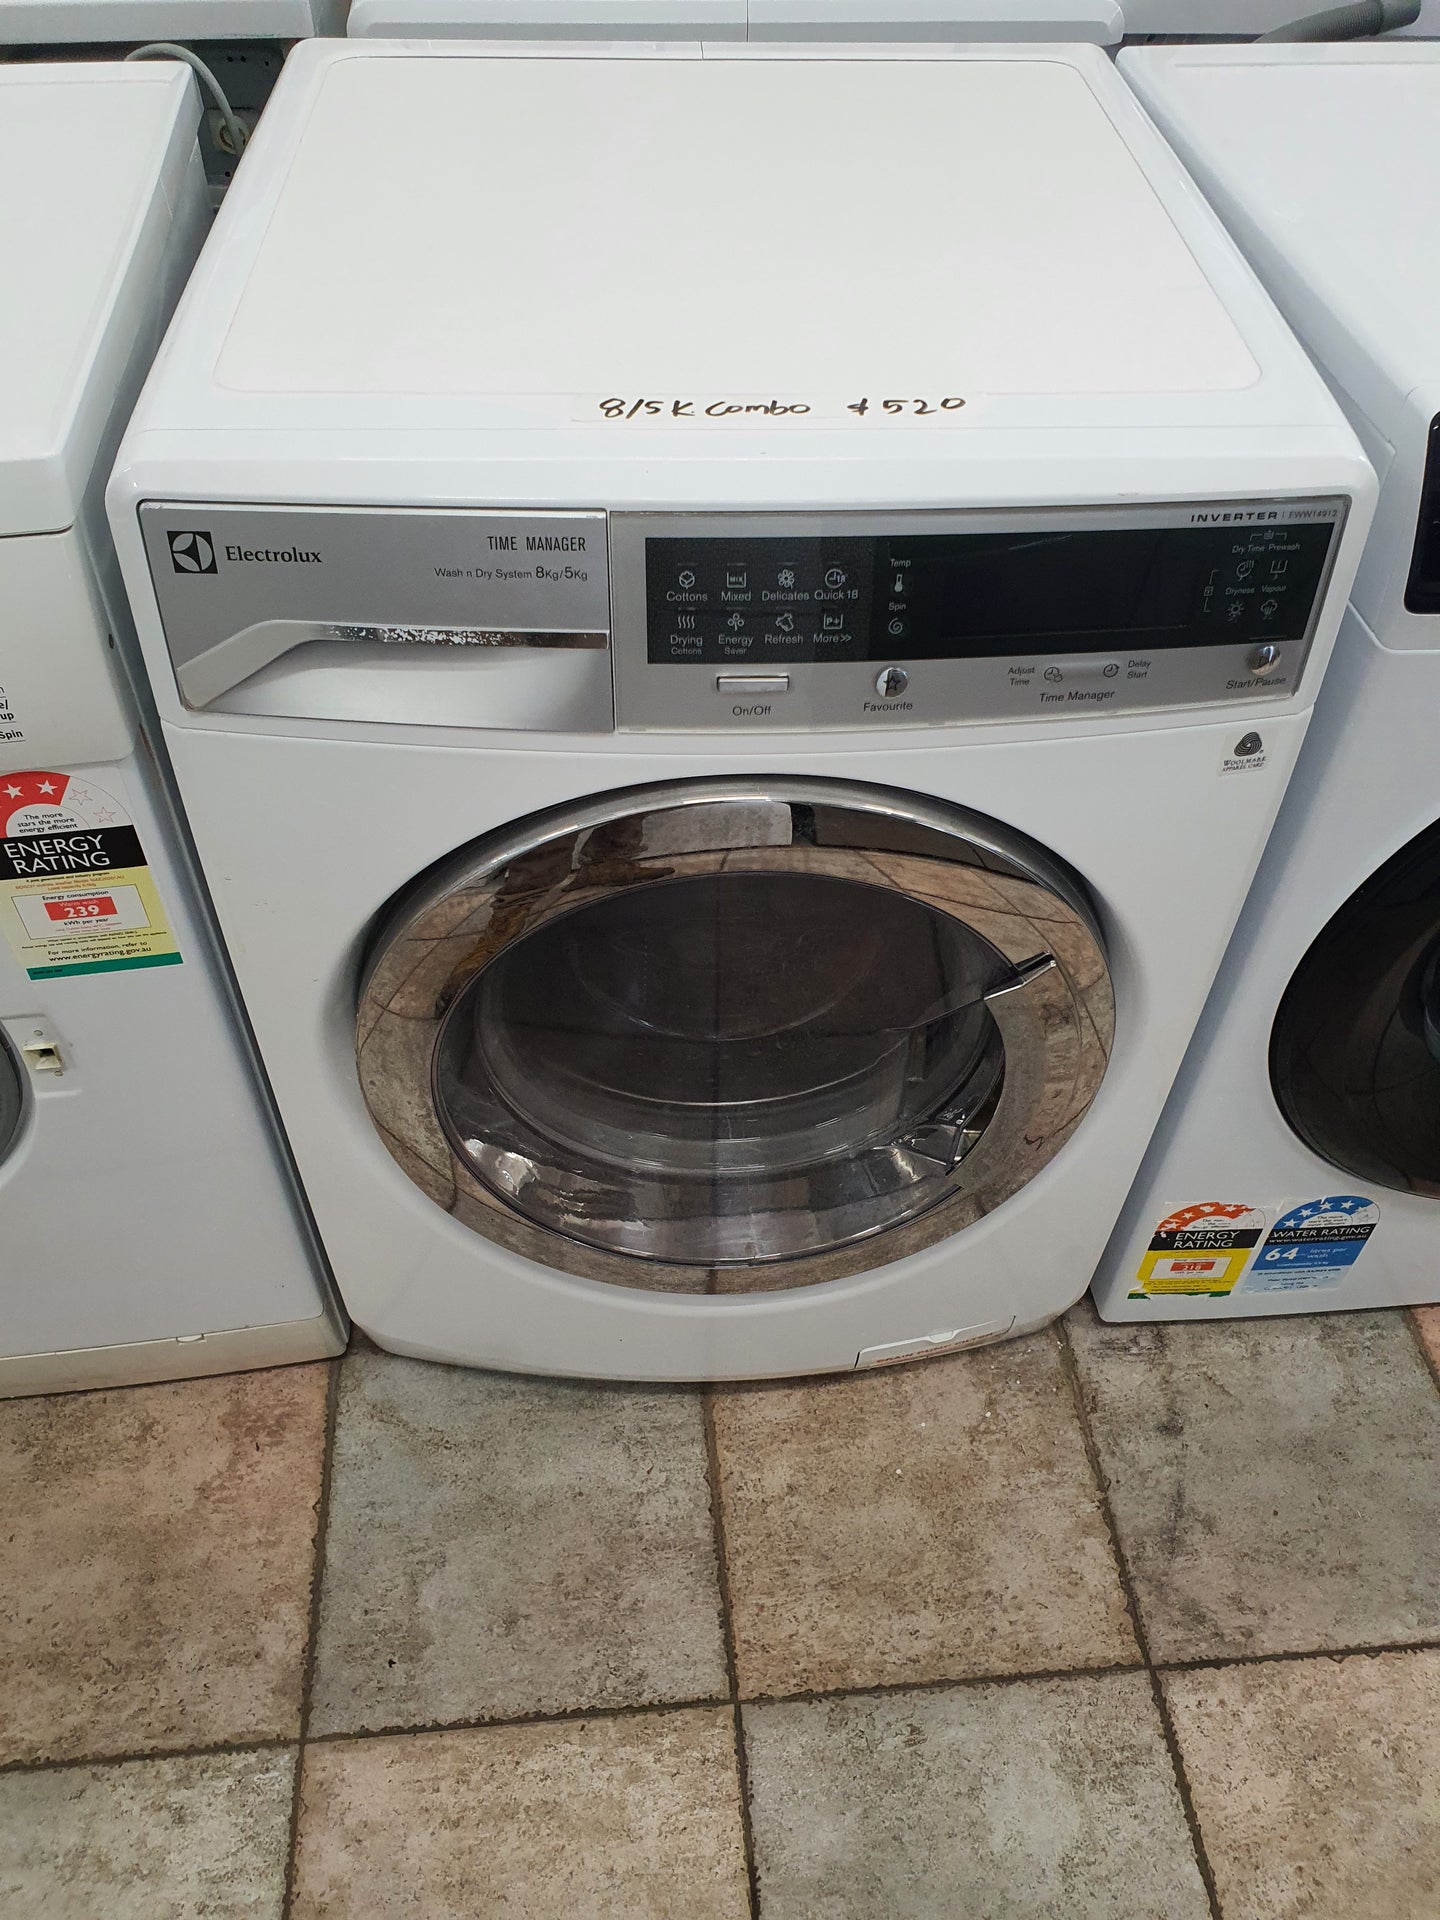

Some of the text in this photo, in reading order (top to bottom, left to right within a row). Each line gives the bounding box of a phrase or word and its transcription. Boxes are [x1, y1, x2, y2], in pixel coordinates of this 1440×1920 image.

[1191, 511, 1278, 523] INVERTER
[487, 535, 587, 553] TIME MANAGER
[1247, 543, 1266, 552] Time
[225, 545, 323, 564] Electrolux
[890, 558, 911, 569] Temp
[434, 567, 464, 579] Wash
[466, 570, 474, 579] n
[475, 568, 493, 581] Dry
[495, 568, 533, 580] System
[666, 591, 708, 603] Cottons
[721, 590, 752, 602] Mixed
[761, 590, 810, 602] Delicates
[814, 589, 859, 601] Quick 18
[888, 602, 907, 612] Spin
[670, 634, 704, 648] Drying
[718, 634, 754, 648] Energy
[764, 633, 804, 645] Refresh
[670, 647, 703, 656] Cottons
[724, 647, 747, 655] Saver
[1127, 660, 1152, 670] Delay
[1007, 666, 1036, 677] Adjust
[1127, 670, 1148, 679] Start
[1009, 677, 1030, 686] Time
[1226, 677, 1287, 690] Start/Pause
[1039, 690, 1116, 704] Time Manager
[732, 705, 773, 717] On/Off
[863, 701, 913, 713] Favourite
[19, 823, 78, 835] energy efficient
[4, 834, 103, 859] ENERGY
[12, 851, 111, 875] RATING
[42, 889, 110, 902] Energy consumption
[64, 904, 100, 919] 239
[82, 918, 95, 926] per
[95, 917, 110, 925] year
[49, 947, 152, 963] www.energyrating.gov.au
[1176, 1230, 1240, 1241] ENERGY
[1272, 1226, 1371, 1238] WATER RATING
[1173, 1239, 1234, 1249] RATING
[1269, 1234, 1367, 1244] www.waterrating.gov.au
[1264, 1247, 1299, 1261] 64
